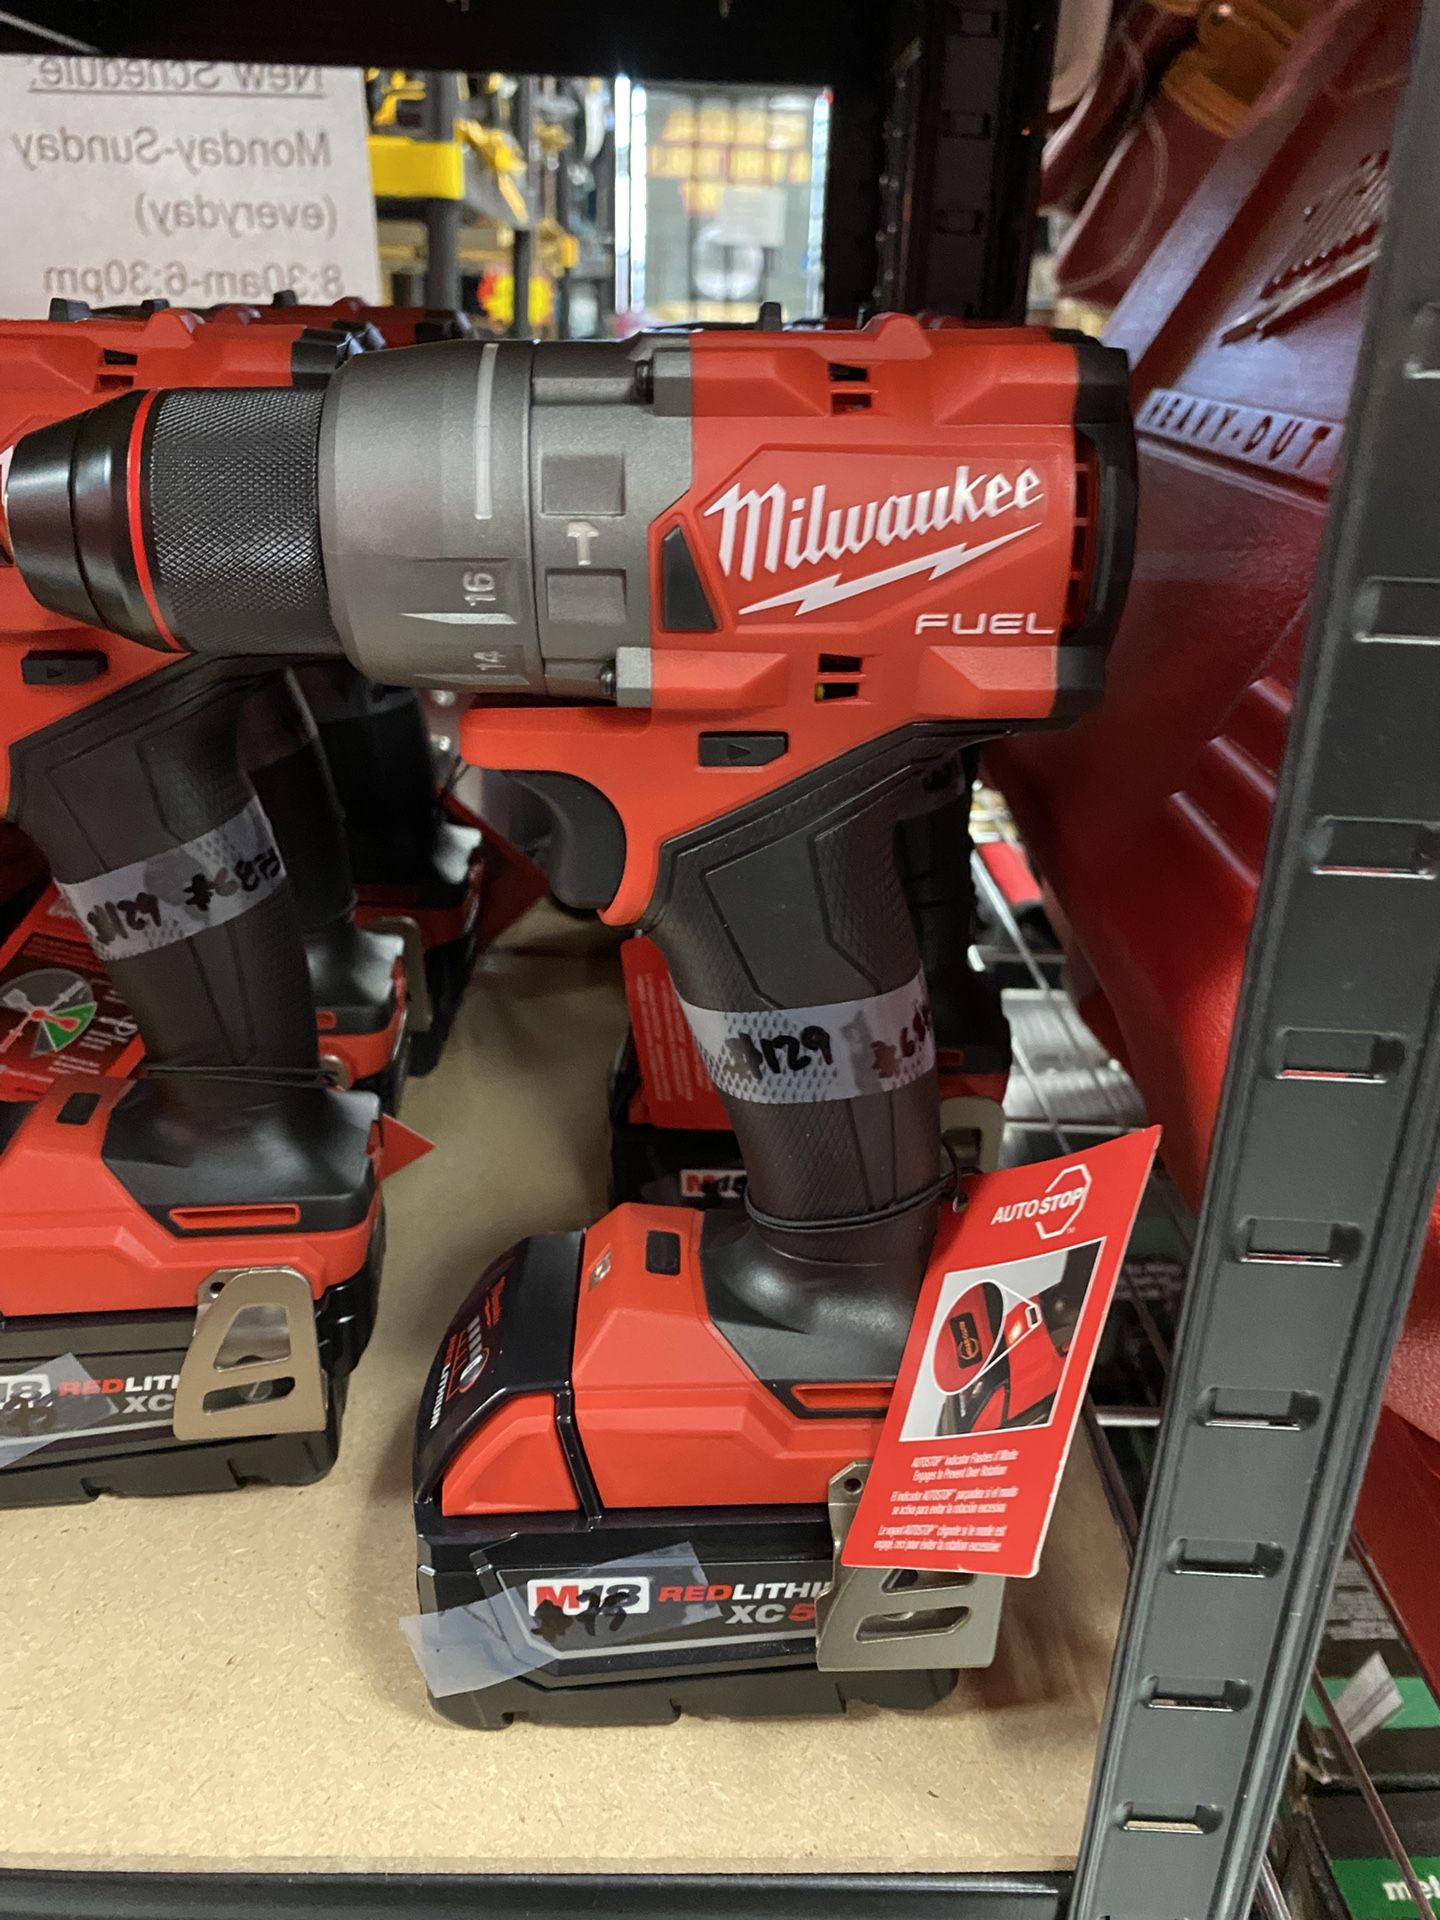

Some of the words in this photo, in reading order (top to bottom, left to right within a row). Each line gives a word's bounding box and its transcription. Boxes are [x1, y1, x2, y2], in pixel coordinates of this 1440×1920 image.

[703, 465, 1045, 582] Milwaukee
[462, 571, 497, 607] 16
[914, 611, 1056, 636] FUEL
[58, 1375, 180, 1397] REDLIT
